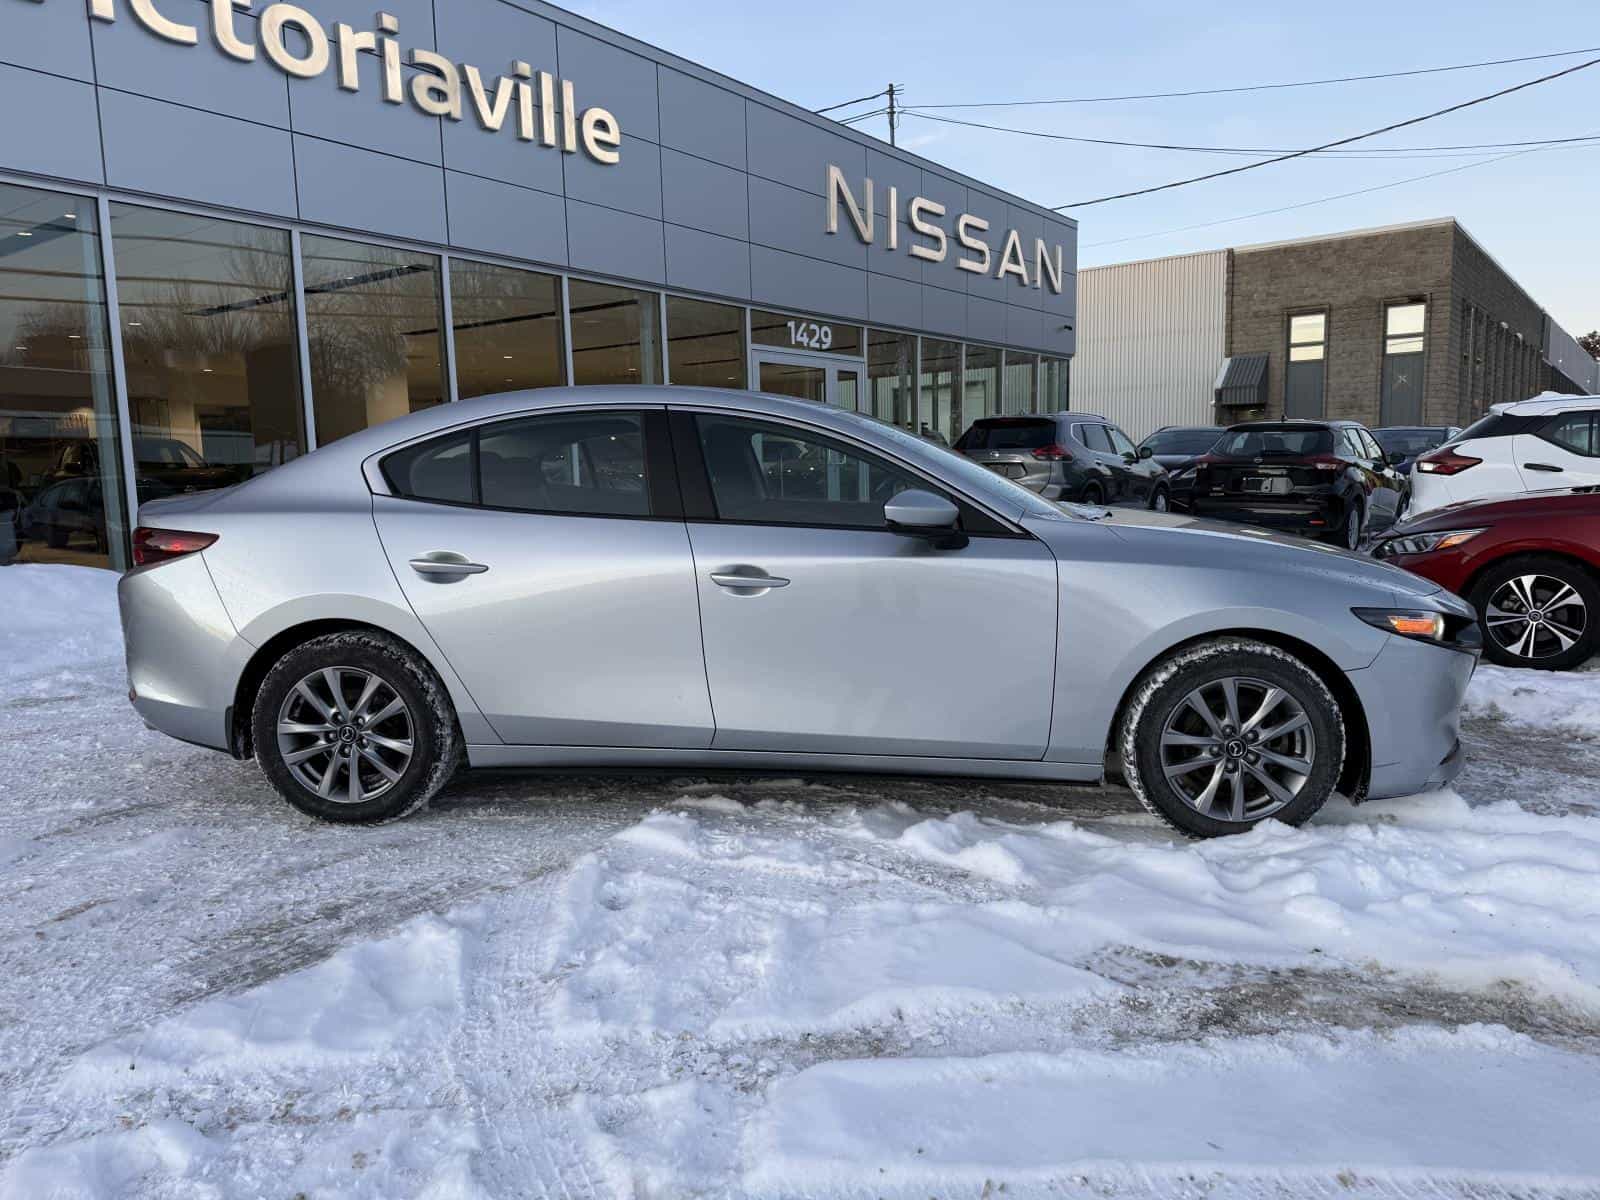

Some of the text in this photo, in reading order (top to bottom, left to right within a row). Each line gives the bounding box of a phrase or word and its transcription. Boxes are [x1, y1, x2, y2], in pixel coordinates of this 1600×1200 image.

[24, 0, 621, 165] ctoriaville
[825, 164, 1063, 294] NISSAN
[787, 320, 832, 350] 1429
